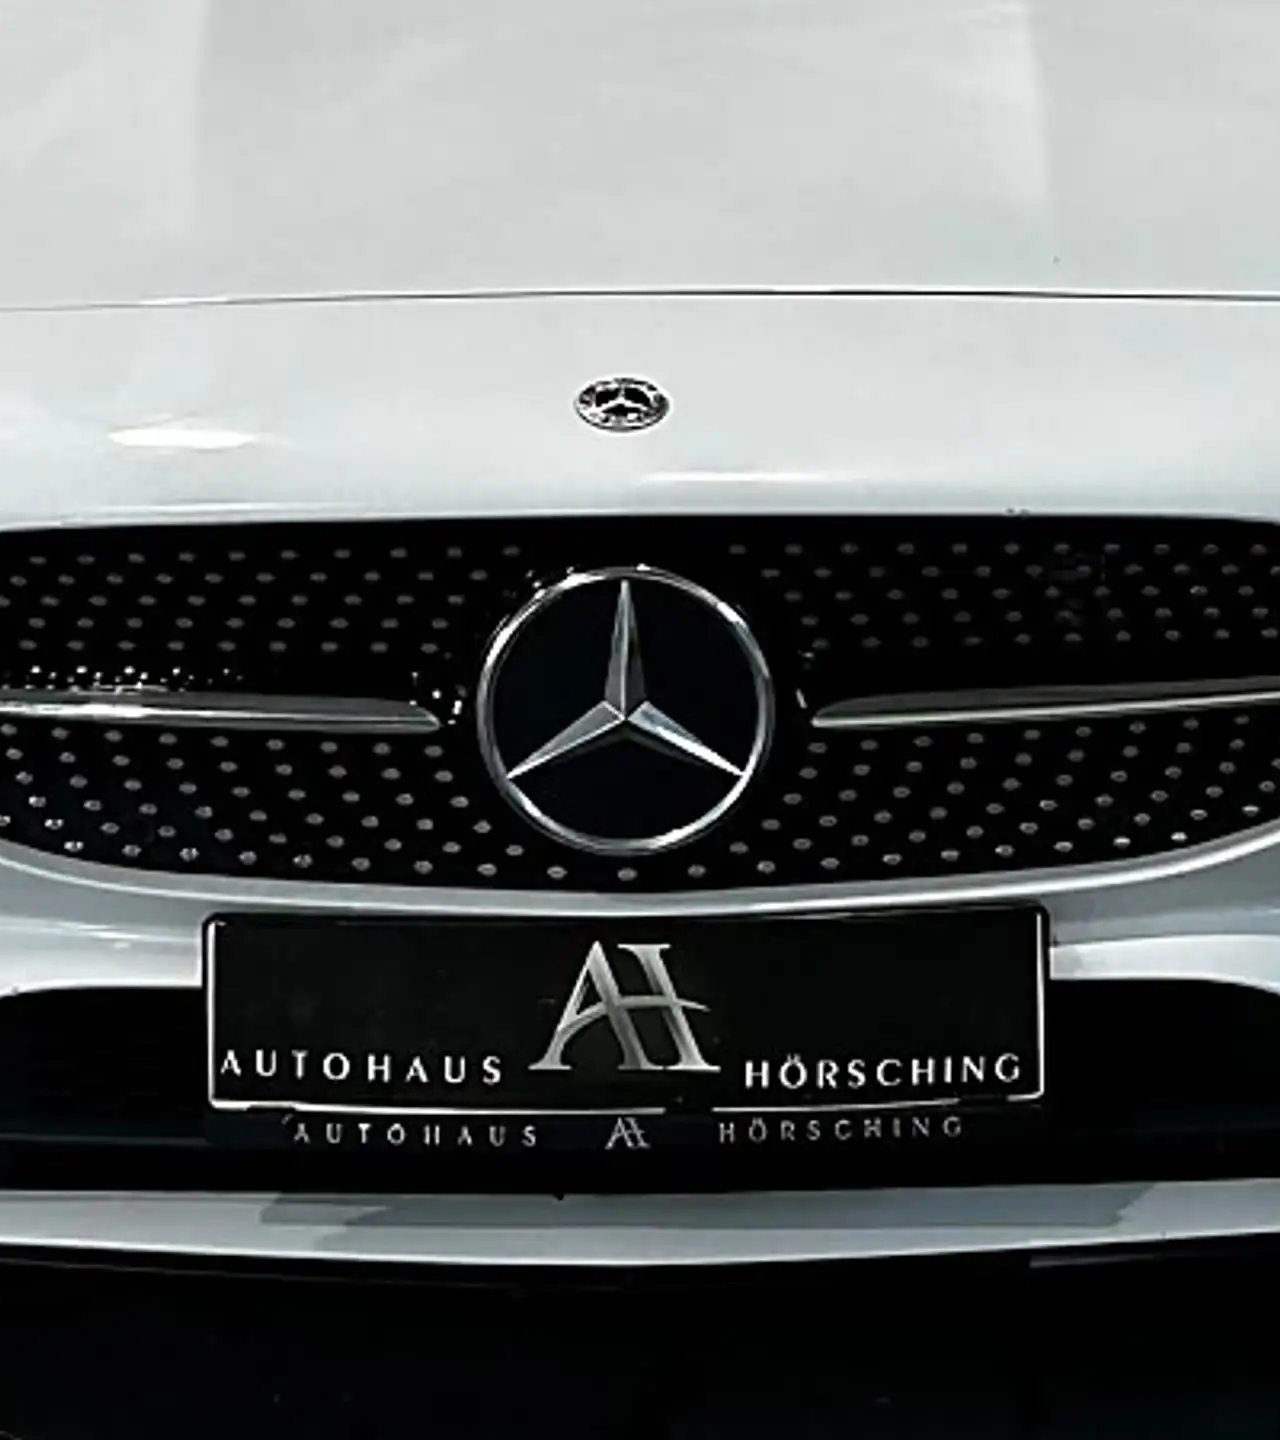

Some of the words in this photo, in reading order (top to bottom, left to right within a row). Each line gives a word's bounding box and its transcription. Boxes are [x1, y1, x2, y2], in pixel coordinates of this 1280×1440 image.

[220, 1048, 503, 1086] AUTOHAUS
[744, 1053, 1021, 1088] HÖRSCHING
[293, 1122, 538, 1148] AUTOHAUS
[719, 1116, 963, 1145] HÖRSCHING
